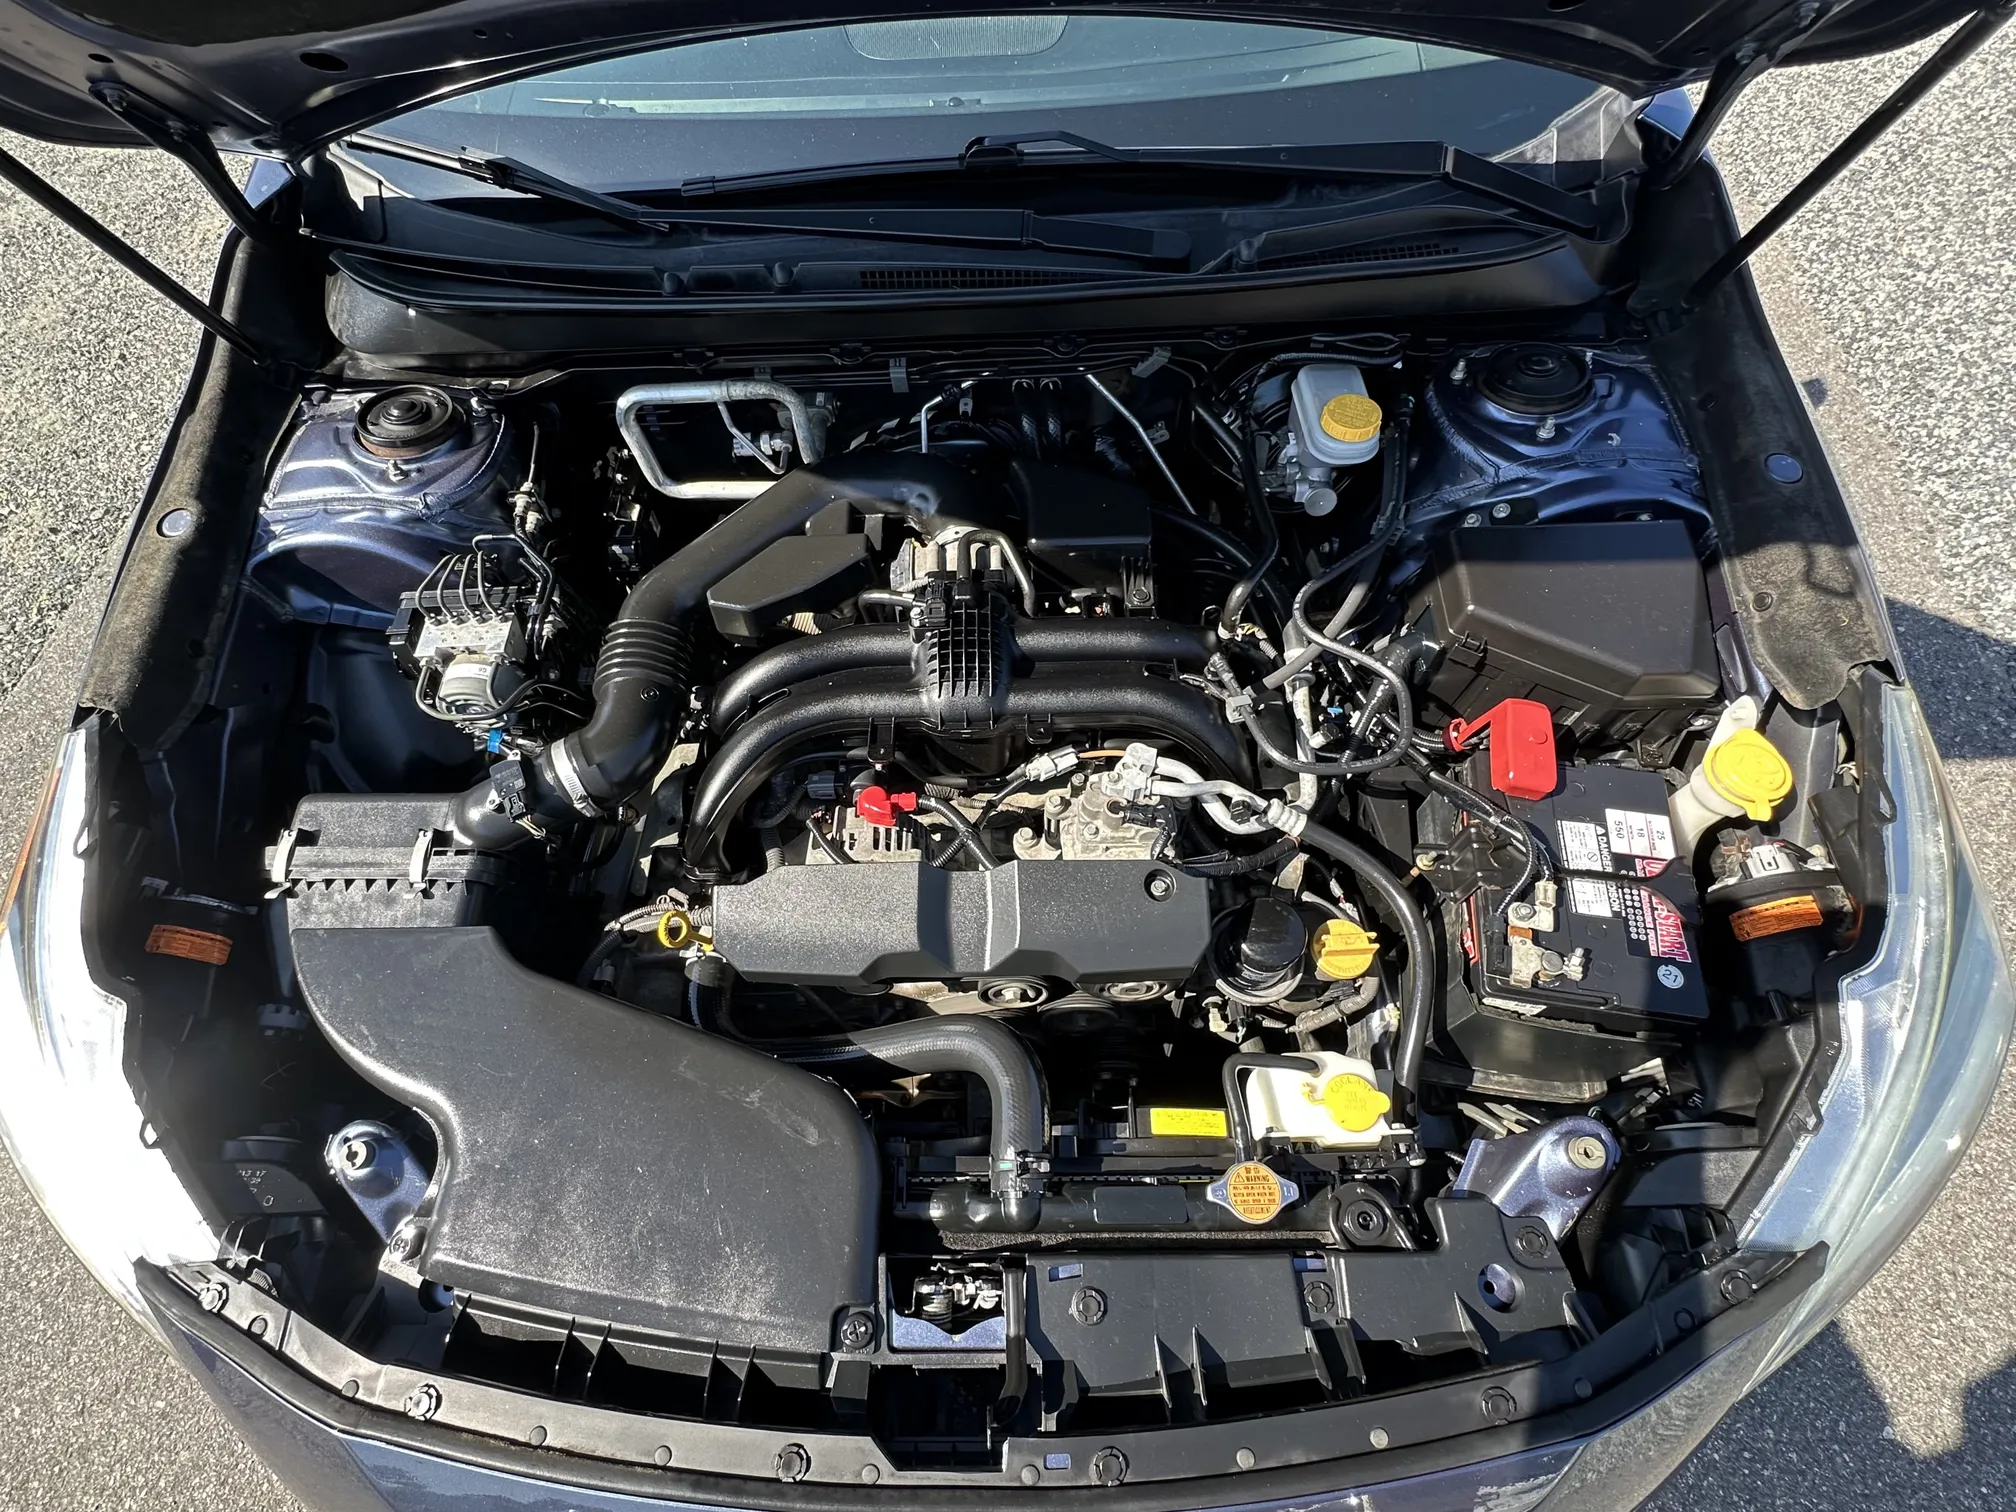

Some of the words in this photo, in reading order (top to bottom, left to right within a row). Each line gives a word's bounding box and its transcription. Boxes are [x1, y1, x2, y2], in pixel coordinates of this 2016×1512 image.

[1614, 820, 1625, 839] 550
[1636, 828, 1645, 838] 18
[1656, 830, 1666, 841] 25
[1598, 835, 1613, 872] DANGER
[1662, 969, 1679, 984] 21
[1245, 1174, 1270, 1183] WARNING
